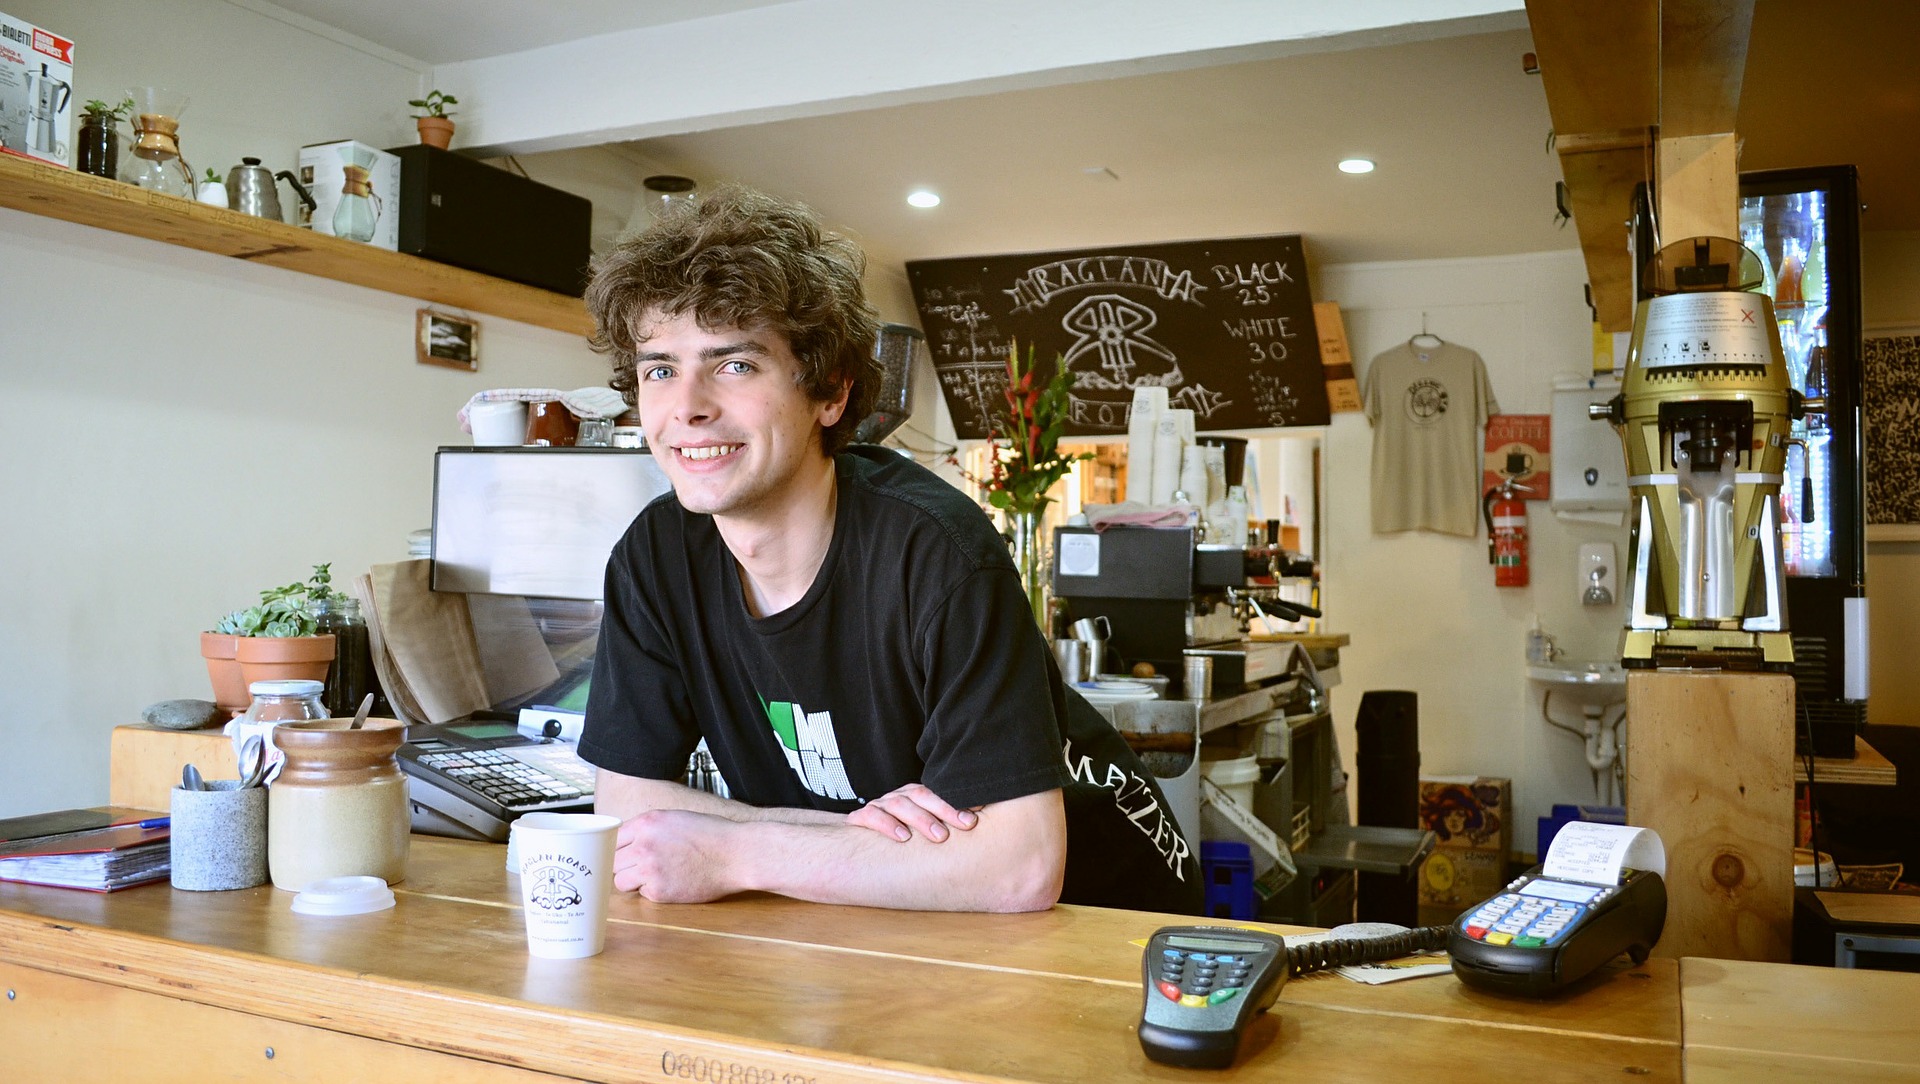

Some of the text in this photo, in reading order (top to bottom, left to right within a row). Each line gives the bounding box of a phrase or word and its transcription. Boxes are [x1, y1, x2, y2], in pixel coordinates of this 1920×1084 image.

[3, 24, 31, 47] BIALETTI
[1035, 258, 1161, 288] RAGLAN
[1211, 261, 1294, 289] BLACK
[1222, 316, 1297, 340] WHITE
[1249, 341, 1288, 362] 30
[1062, 737, 1189, 882] MAZZER
[522, 853, 593, 877] RAGLAN ROAST
[661, 1050, 723, 1084] 0800
